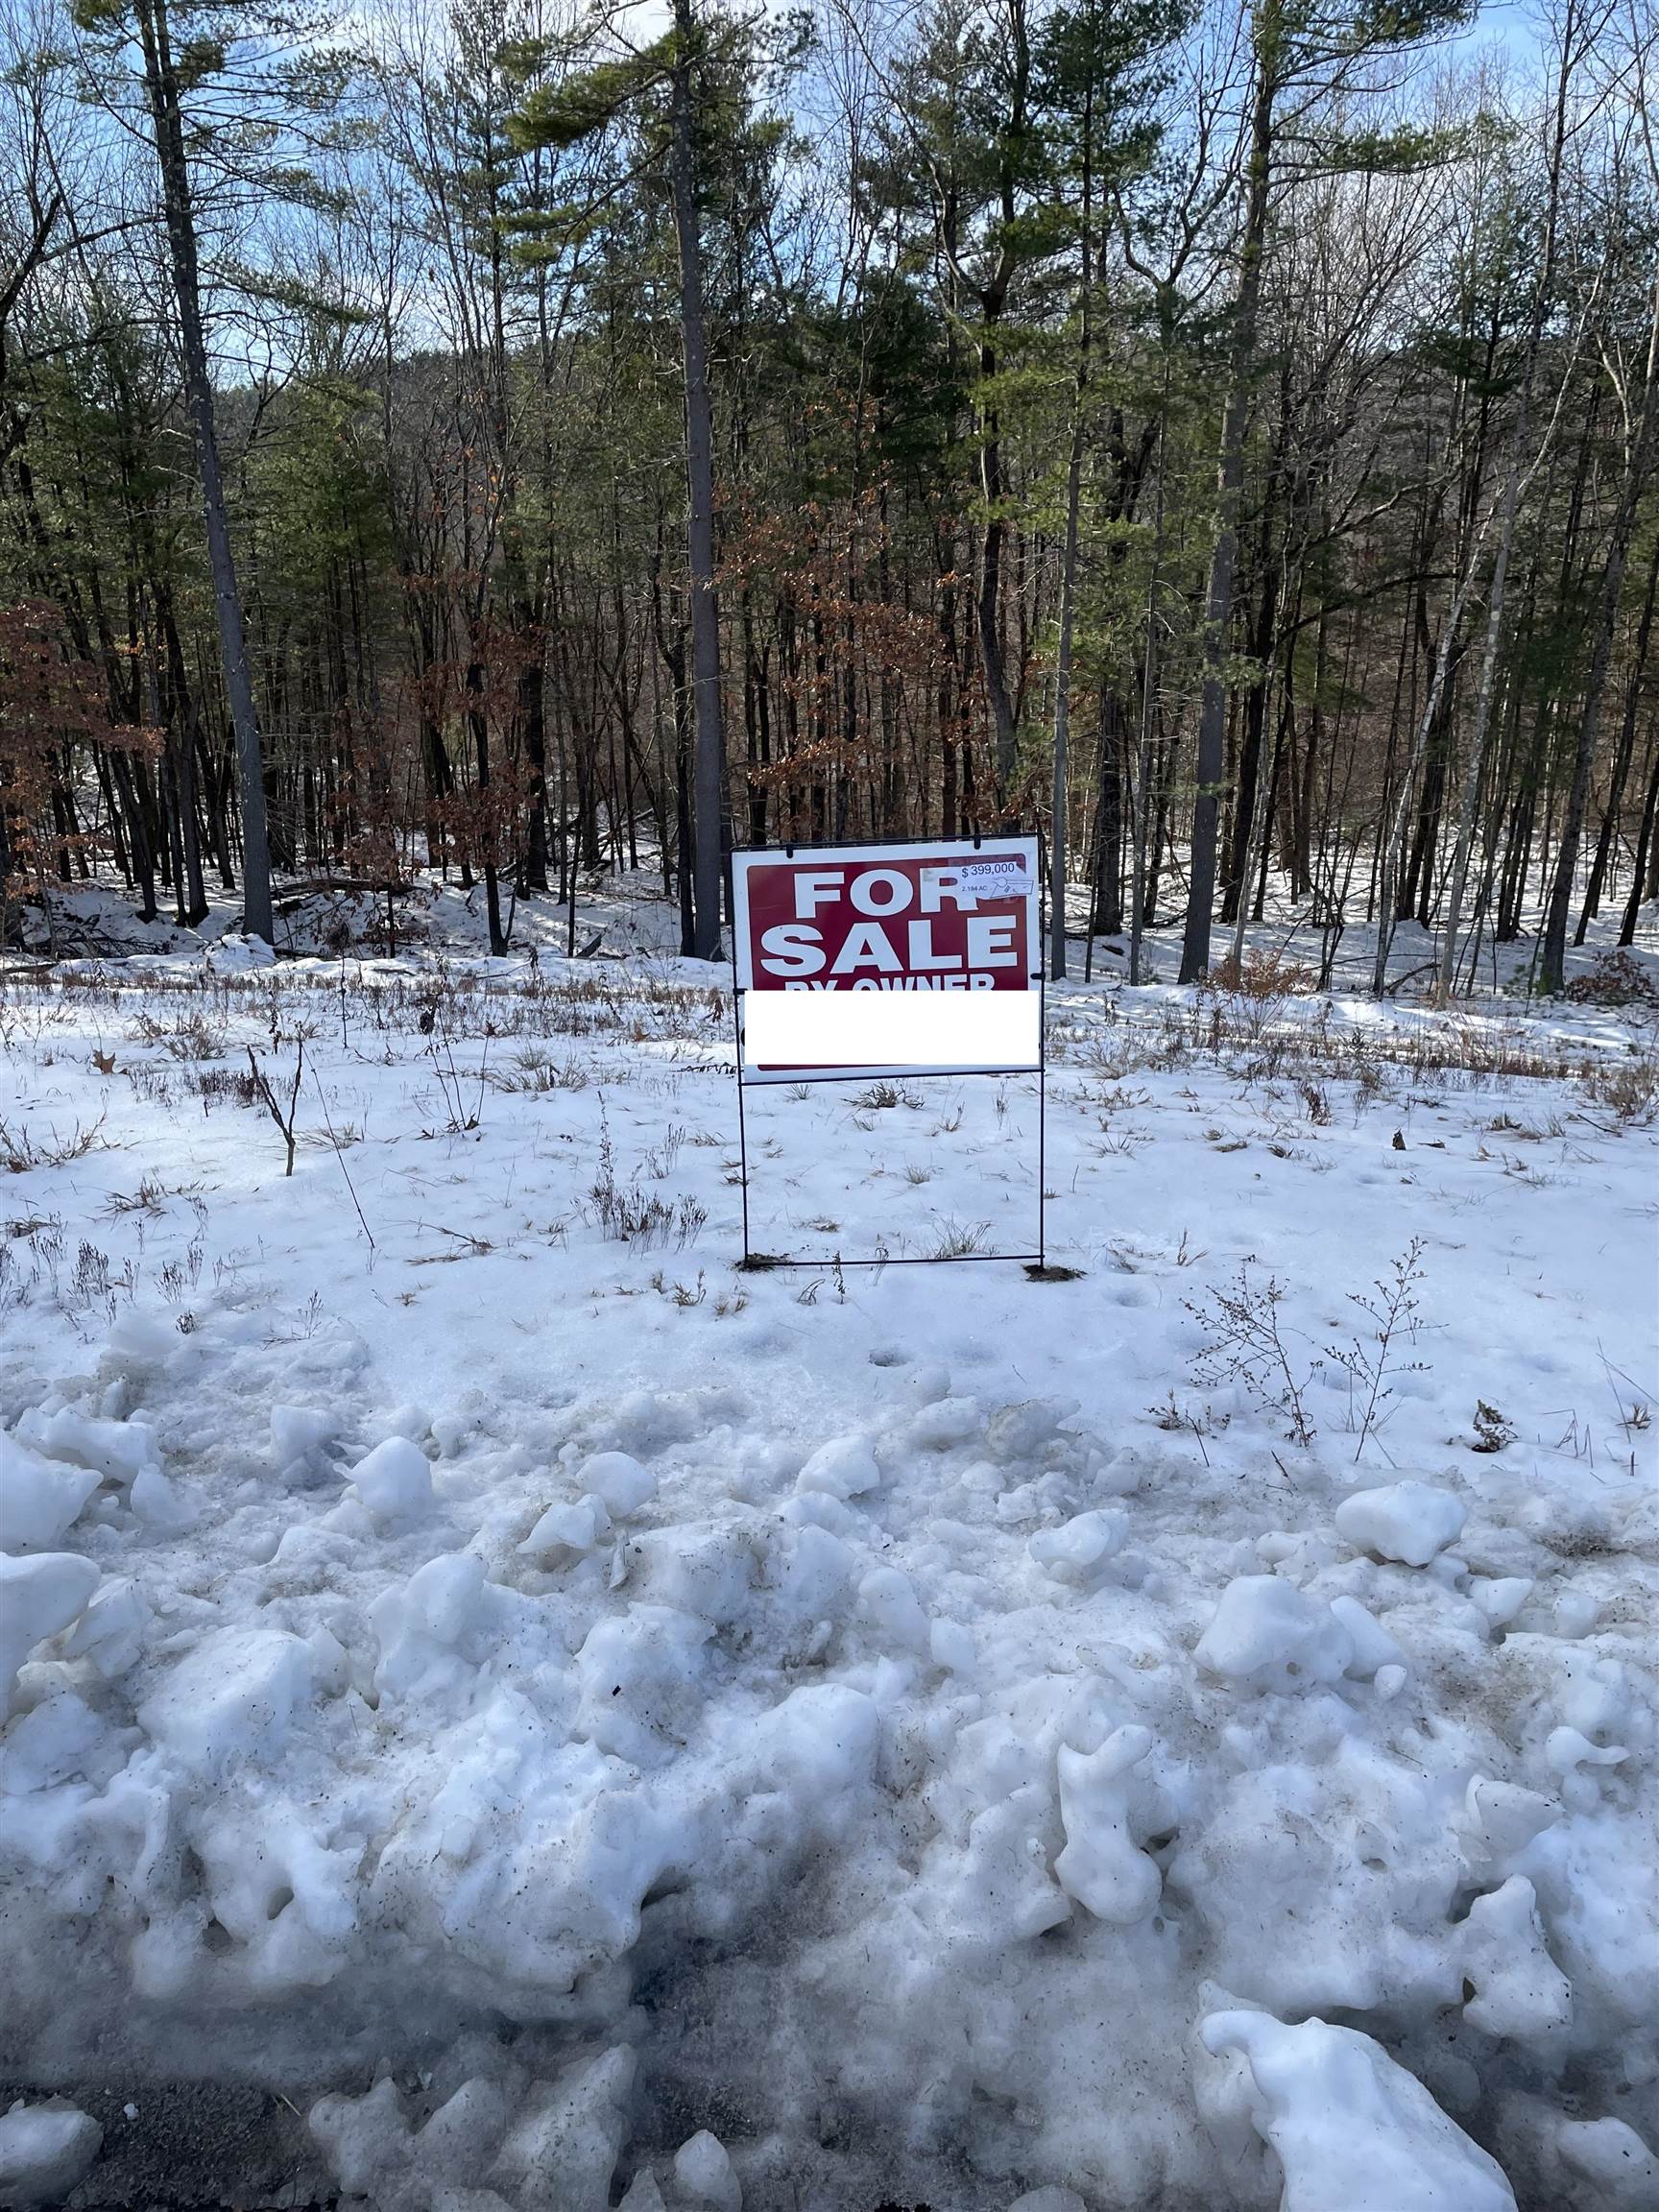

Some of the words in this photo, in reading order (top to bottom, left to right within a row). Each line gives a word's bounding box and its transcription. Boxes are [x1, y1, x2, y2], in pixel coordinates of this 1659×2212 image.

[794, 866, 979, 919] FOR
[961, 867, 969, 878] $
[971, 862, 1015, 876] 399,000
[760, 915, 1018, 977] SALE
